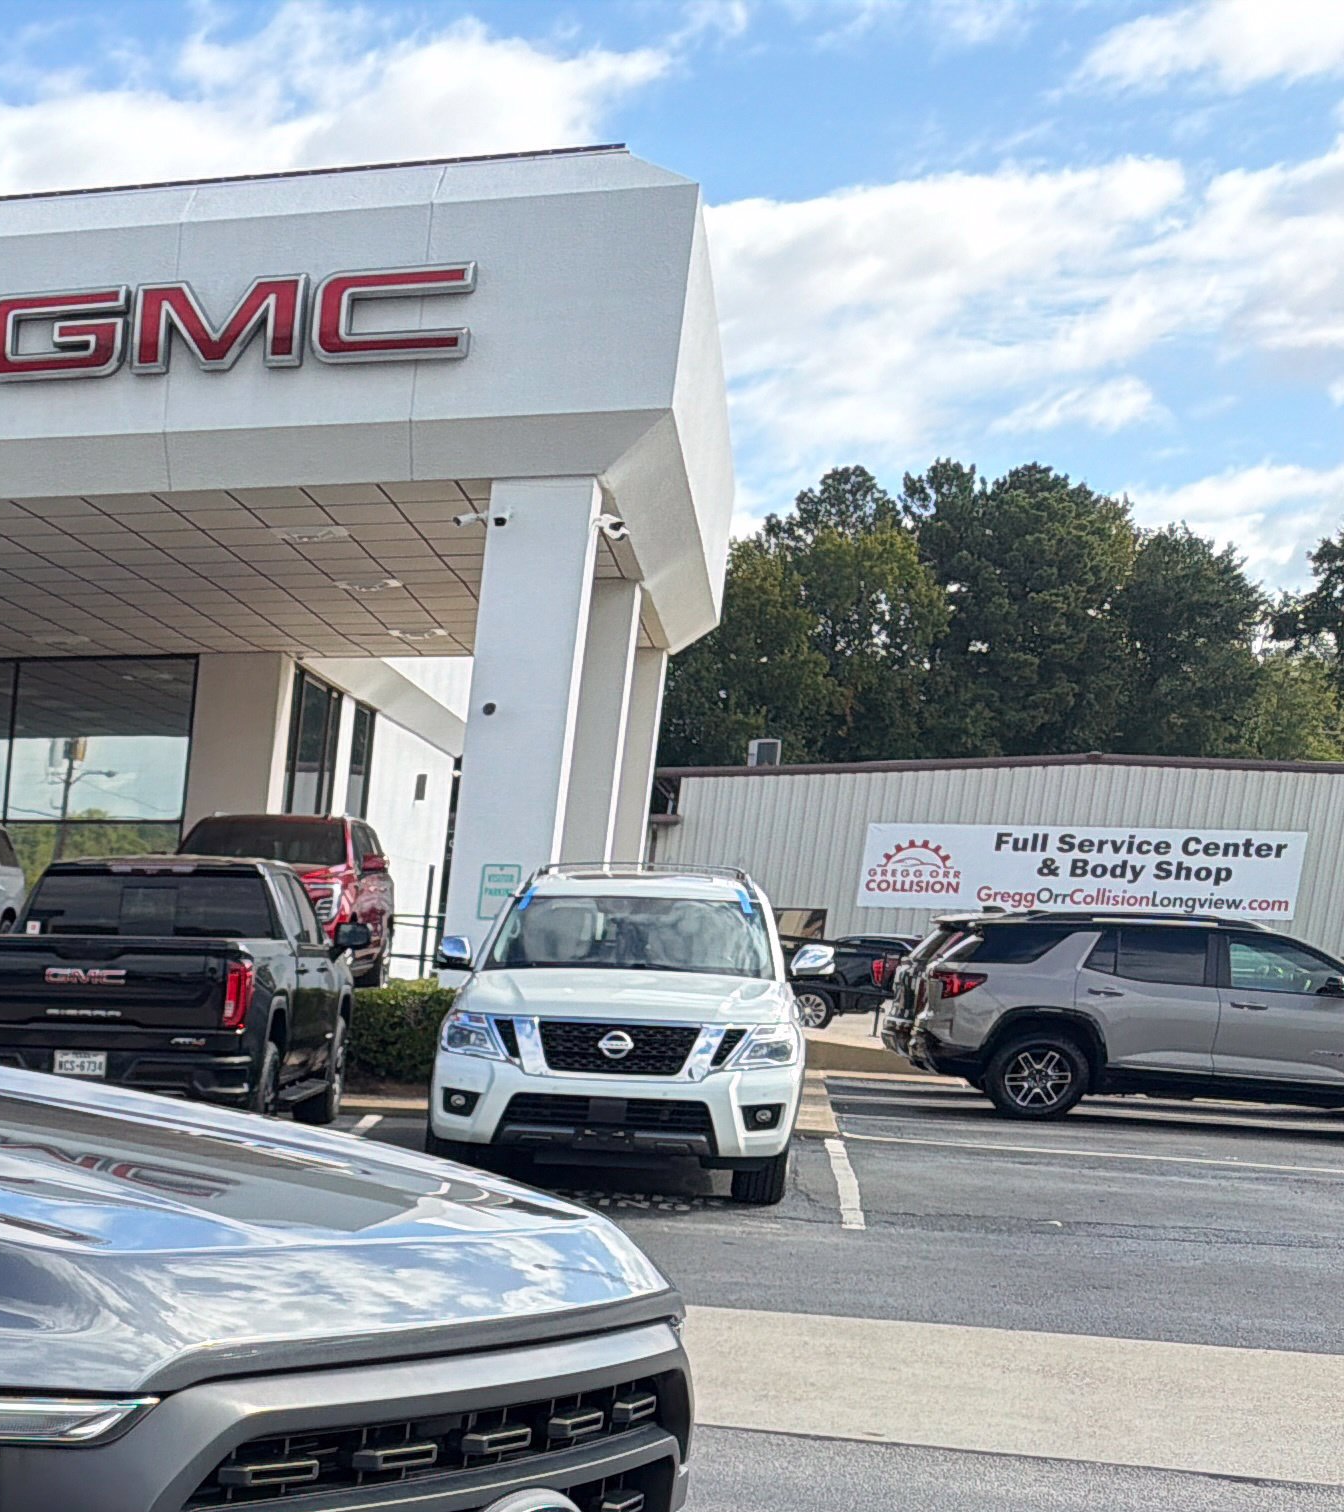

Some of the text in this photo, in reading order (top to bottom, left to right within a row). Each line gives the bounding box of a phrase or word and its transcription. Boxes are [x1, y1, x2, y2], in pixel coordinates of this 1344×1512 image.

[994, 832, 1289, 859] Full Service Center
[867, 867, 962, 880] GREGG ORR
[1037, 857, 1233, 887] & Body Shop
[865, 879, 961, 894] COLLISION
[976, 885, 1290, 914] GreggOrrCollisionLongview.com
[45, 967, 127, 985] GMC
